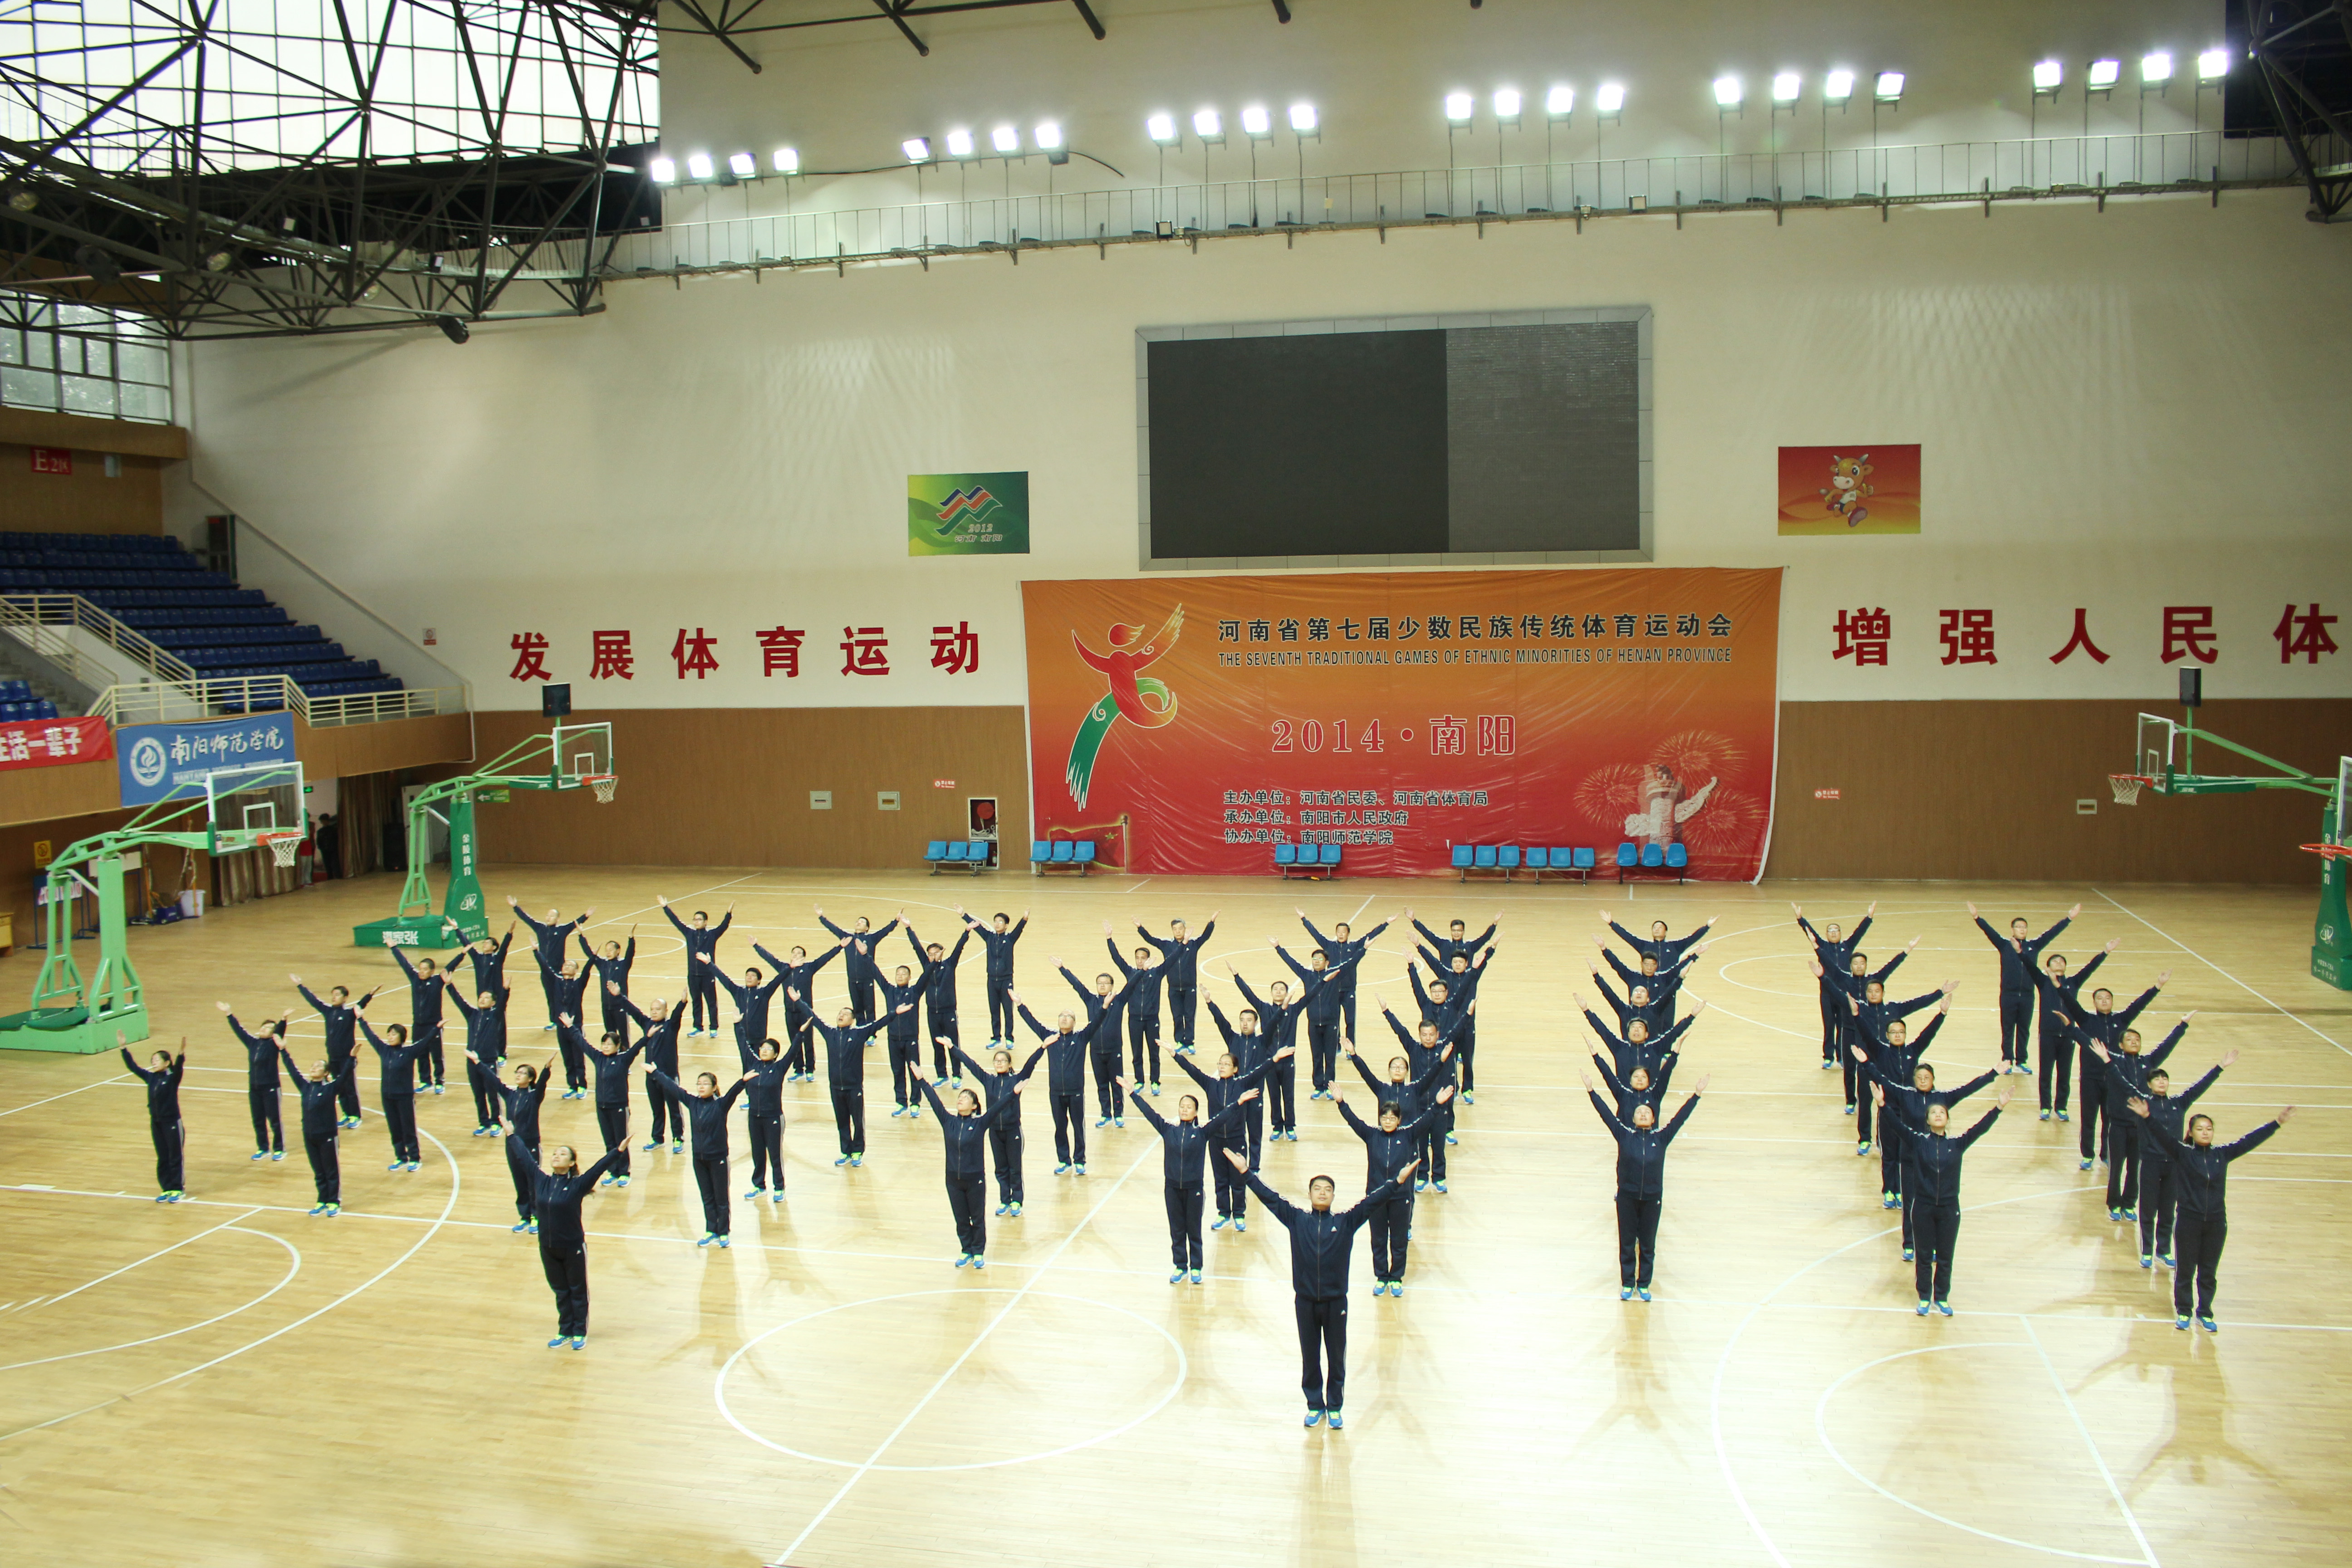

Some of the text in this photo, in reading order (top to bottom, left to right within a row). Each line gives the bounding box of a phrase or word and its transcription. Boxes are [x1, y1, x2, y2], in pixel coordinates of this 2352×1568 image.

[968, 524, 993, 533] 2012
[1218, 612, 1733, 642] 河南省第七届少数民族传统体育运动会
[1832, 603, 2340, 666] 增强人民体
[509, 621, 980, 682] 发展体育运动
[1218, 647, 1732, 667] THE SEVENTH TRADITIONAL GAMES OF ETHNIC MINORITIES OF HENAN PROVINCE
[171, 726, 284, 766] 南阳师范学院
